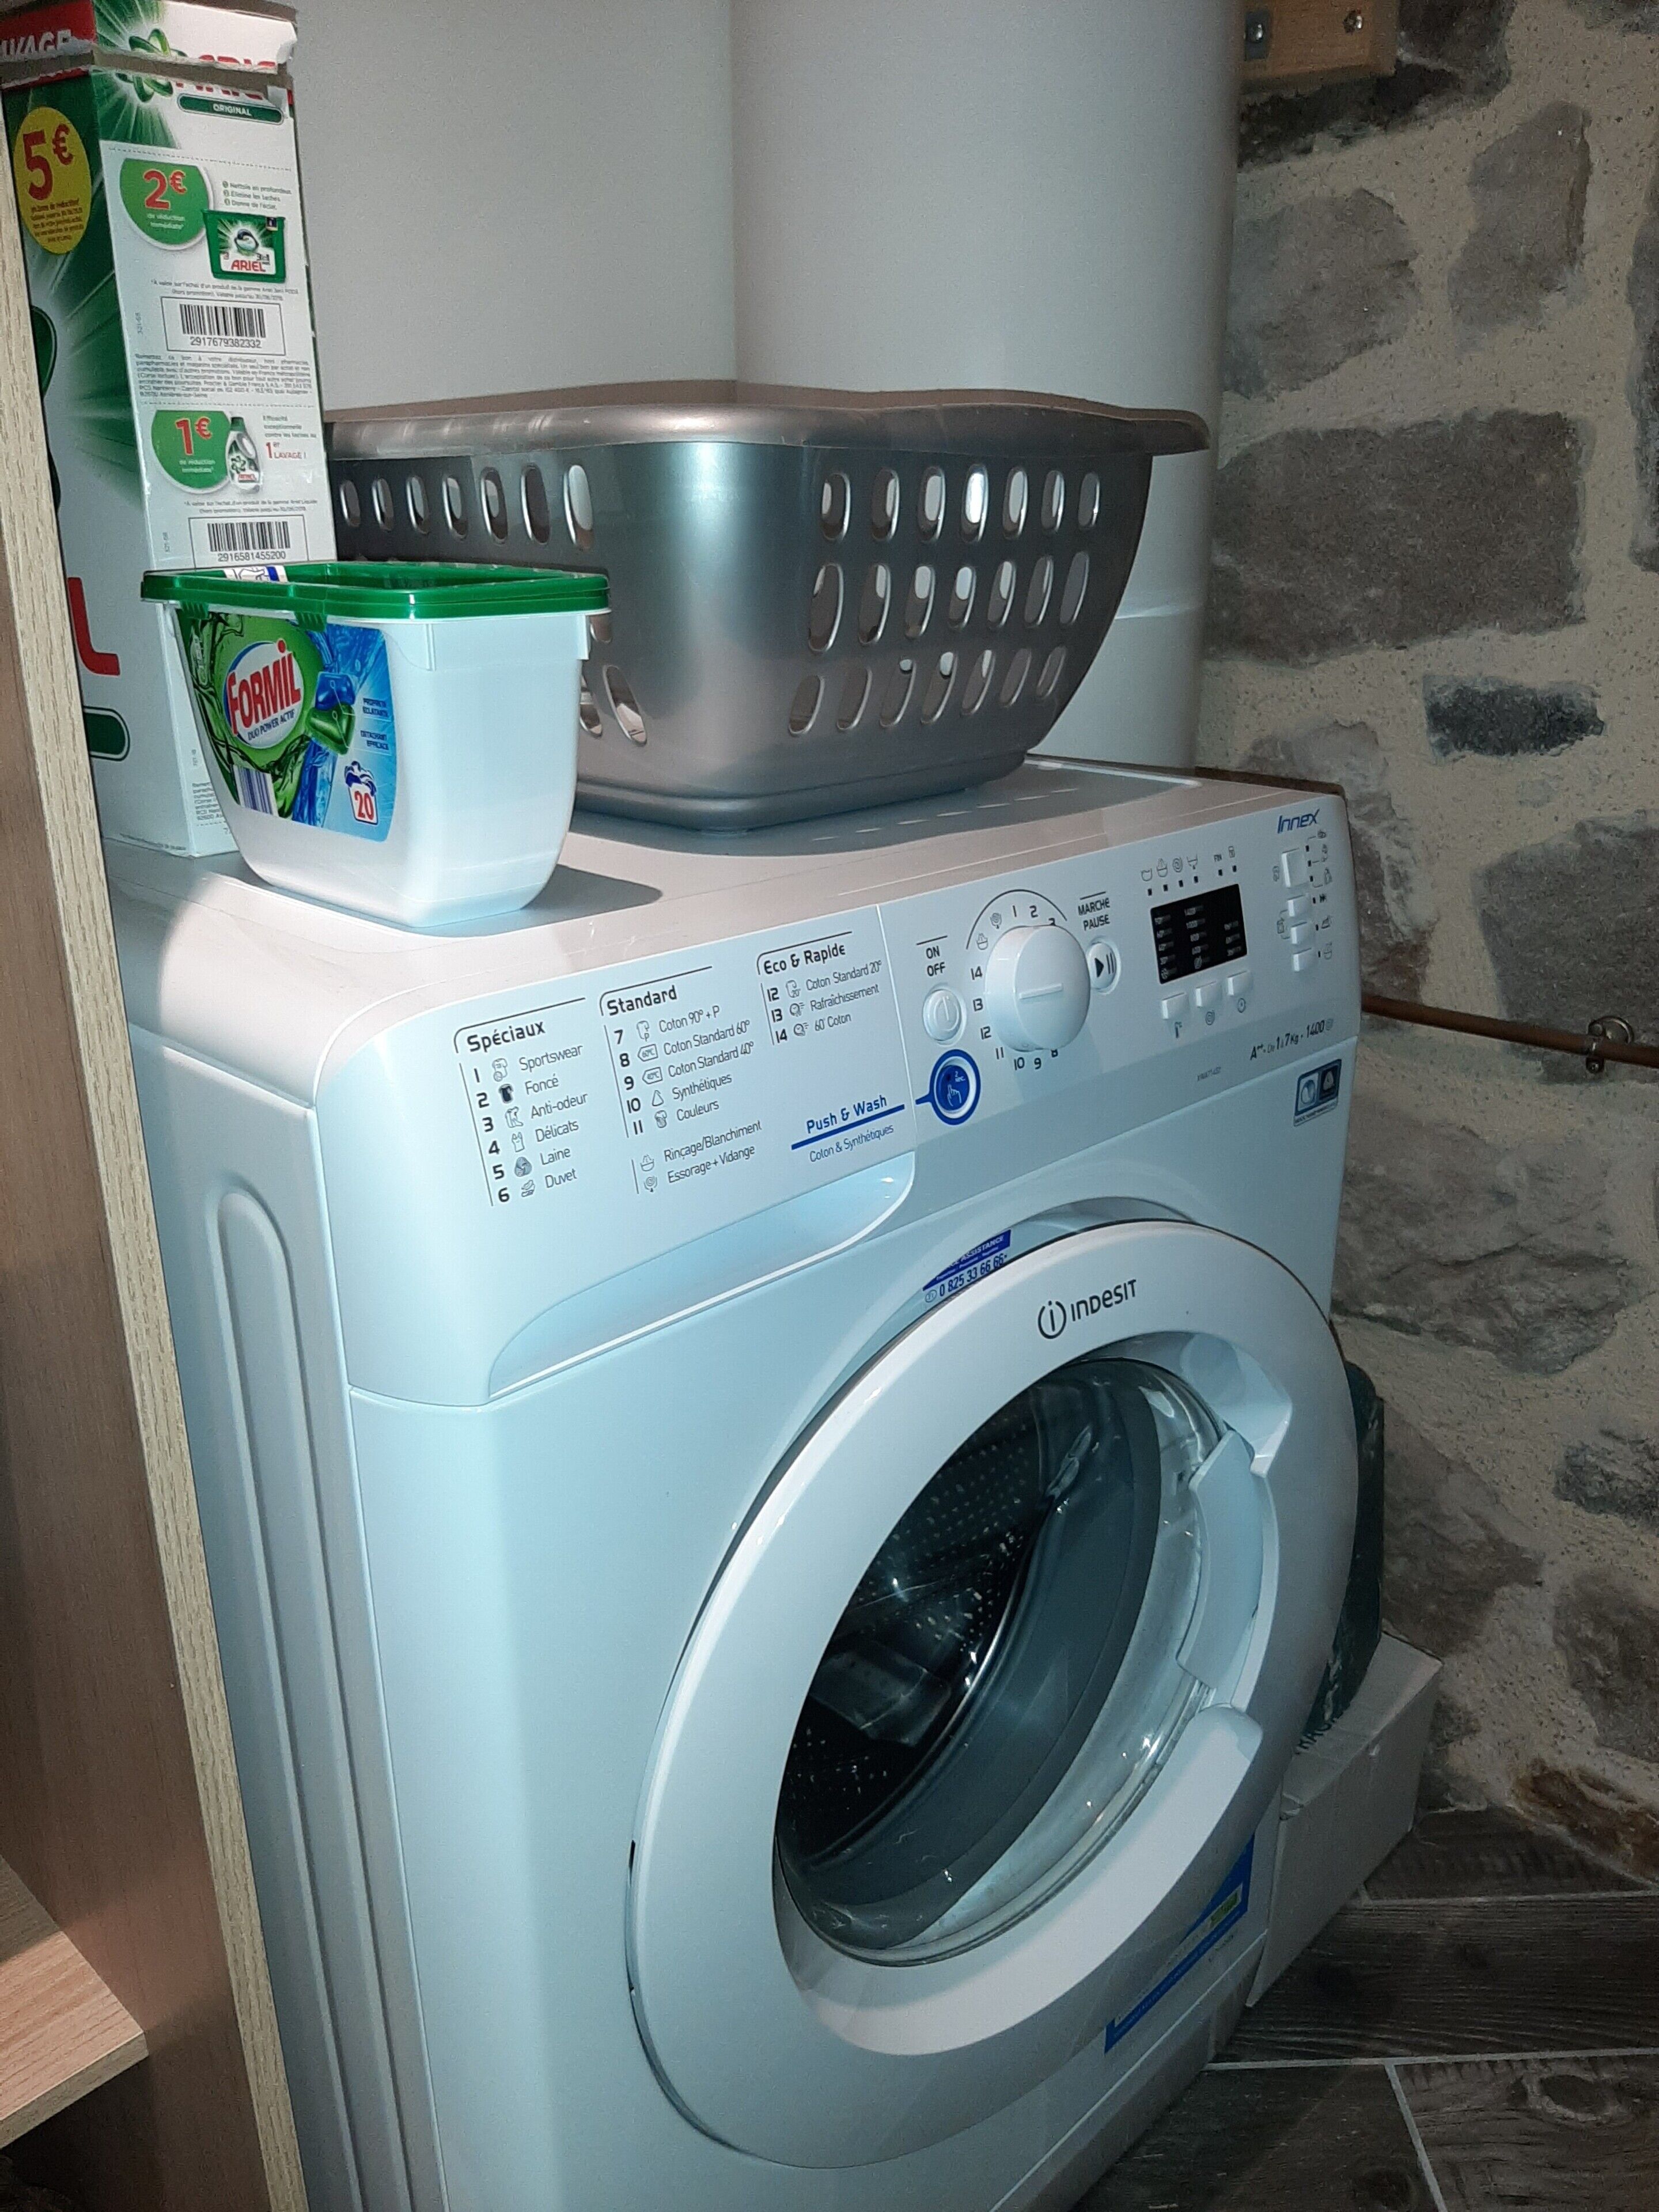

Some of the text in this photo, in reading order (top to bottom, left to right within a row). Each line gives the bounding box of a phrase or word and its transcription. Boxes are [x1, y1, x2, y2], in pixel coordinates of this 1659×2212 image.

[213, 103, 252, 116] ORIGINAL
[143, 169, 188, 211] 2€
[231, 259, 266, 272] ARIEL
[175, 416, 212, 456] 1€
[226, 638, 301, 736] FORMIL
[260, 717, 279, 735] POWER
[355, 790, 375, 821] 20
[1278, 809, 1320, 834] Innex
[1012, 905, 1017, 918] 1
[1029, 905, 1039, 918] 2
[1078, 897, 1111, 916] MARCHE
[1084, 915, 1111, 931] PAUSE
[926, 945, 941, 960] ON
[764, 958, 787, 975] Eco
[790, 953, 801, 968] &
[927, 962, 946, 977] OFF
[971, 965, 983, 980] 14
[806, 976, 831, 992] Coton
[833, 964, 869, 984] Standard
[607, 985, 677, 1016] Standard
[767, 987, 779, 1002] 12
[810, 983, 880, 1012] Rafraîchissement
[973, 998, 983, 1012] 13
[659, 1018, 688, 1033] Coton
[713, 1005, 721, 1018] P
[771, 1008, 783, 1022] 13
[827, 1012, 851, 1029] Coton
[467, 1021, 546, 1053] Spéciaux
[614, 1029, 623, 1045] 7
[664, 1040, 692, 1056] Coton
[694, 1025, 734, 1048] Standard
[775, 1029, 787, 1044] 14
[980, 1026, 991, 1040] 12
[518, 1044, 583, 1073] Sportswear
[619, 1052, 630, 1067] 8
[995, 1047, 1005, 1059] 11
[668, 1062, 697, 1078] Coton
[698, 1047, 739, 1069] Standard
[1014, 1057, 1025, 1071] 10
[1034, 1058, 1042, 1070] 9
[474, 1068, 481, 1083] 1
[525, 1073, 559, 1095] Foncé
[624, 1075, 634, 1090] 9
[672, 1074, 732, 1101] Synthétiques
[476, 1092, 490, 1108] 2
[531, 1094, 588, 1119] Anti-odeur
[627, 1097, 641, 1114] 10
[676, 1100, 719, 1122] Couleurs
[806, 1094, 887, 1134] Push & Wash
[482, 1116, 494, 1132] 3
[535, 1120, 579, 1142] Délicats
[633, 1119, 644, 1135] 11
[488, 1141, 501, 1155] 4
[664, 1120, 762, 1162] Rinçage/Blanchiment
[809, 1124, 894, 1163] Coton & Synthétiques
[540, 1147, 571, 1166] Laine
[719, 1145, 755, 1166] Vidange
[493, 1164, 505, 1180] 5
[545, 1168, 578, 1188] Duvet
[498, 1187, 510, 1203] 6
[940, 1284, 945, 1297] 0
[948, 1274, 964, 1292] 825
[967, 1267, 978, 1282] 33
[980, 1259, 991, 1275] 66
